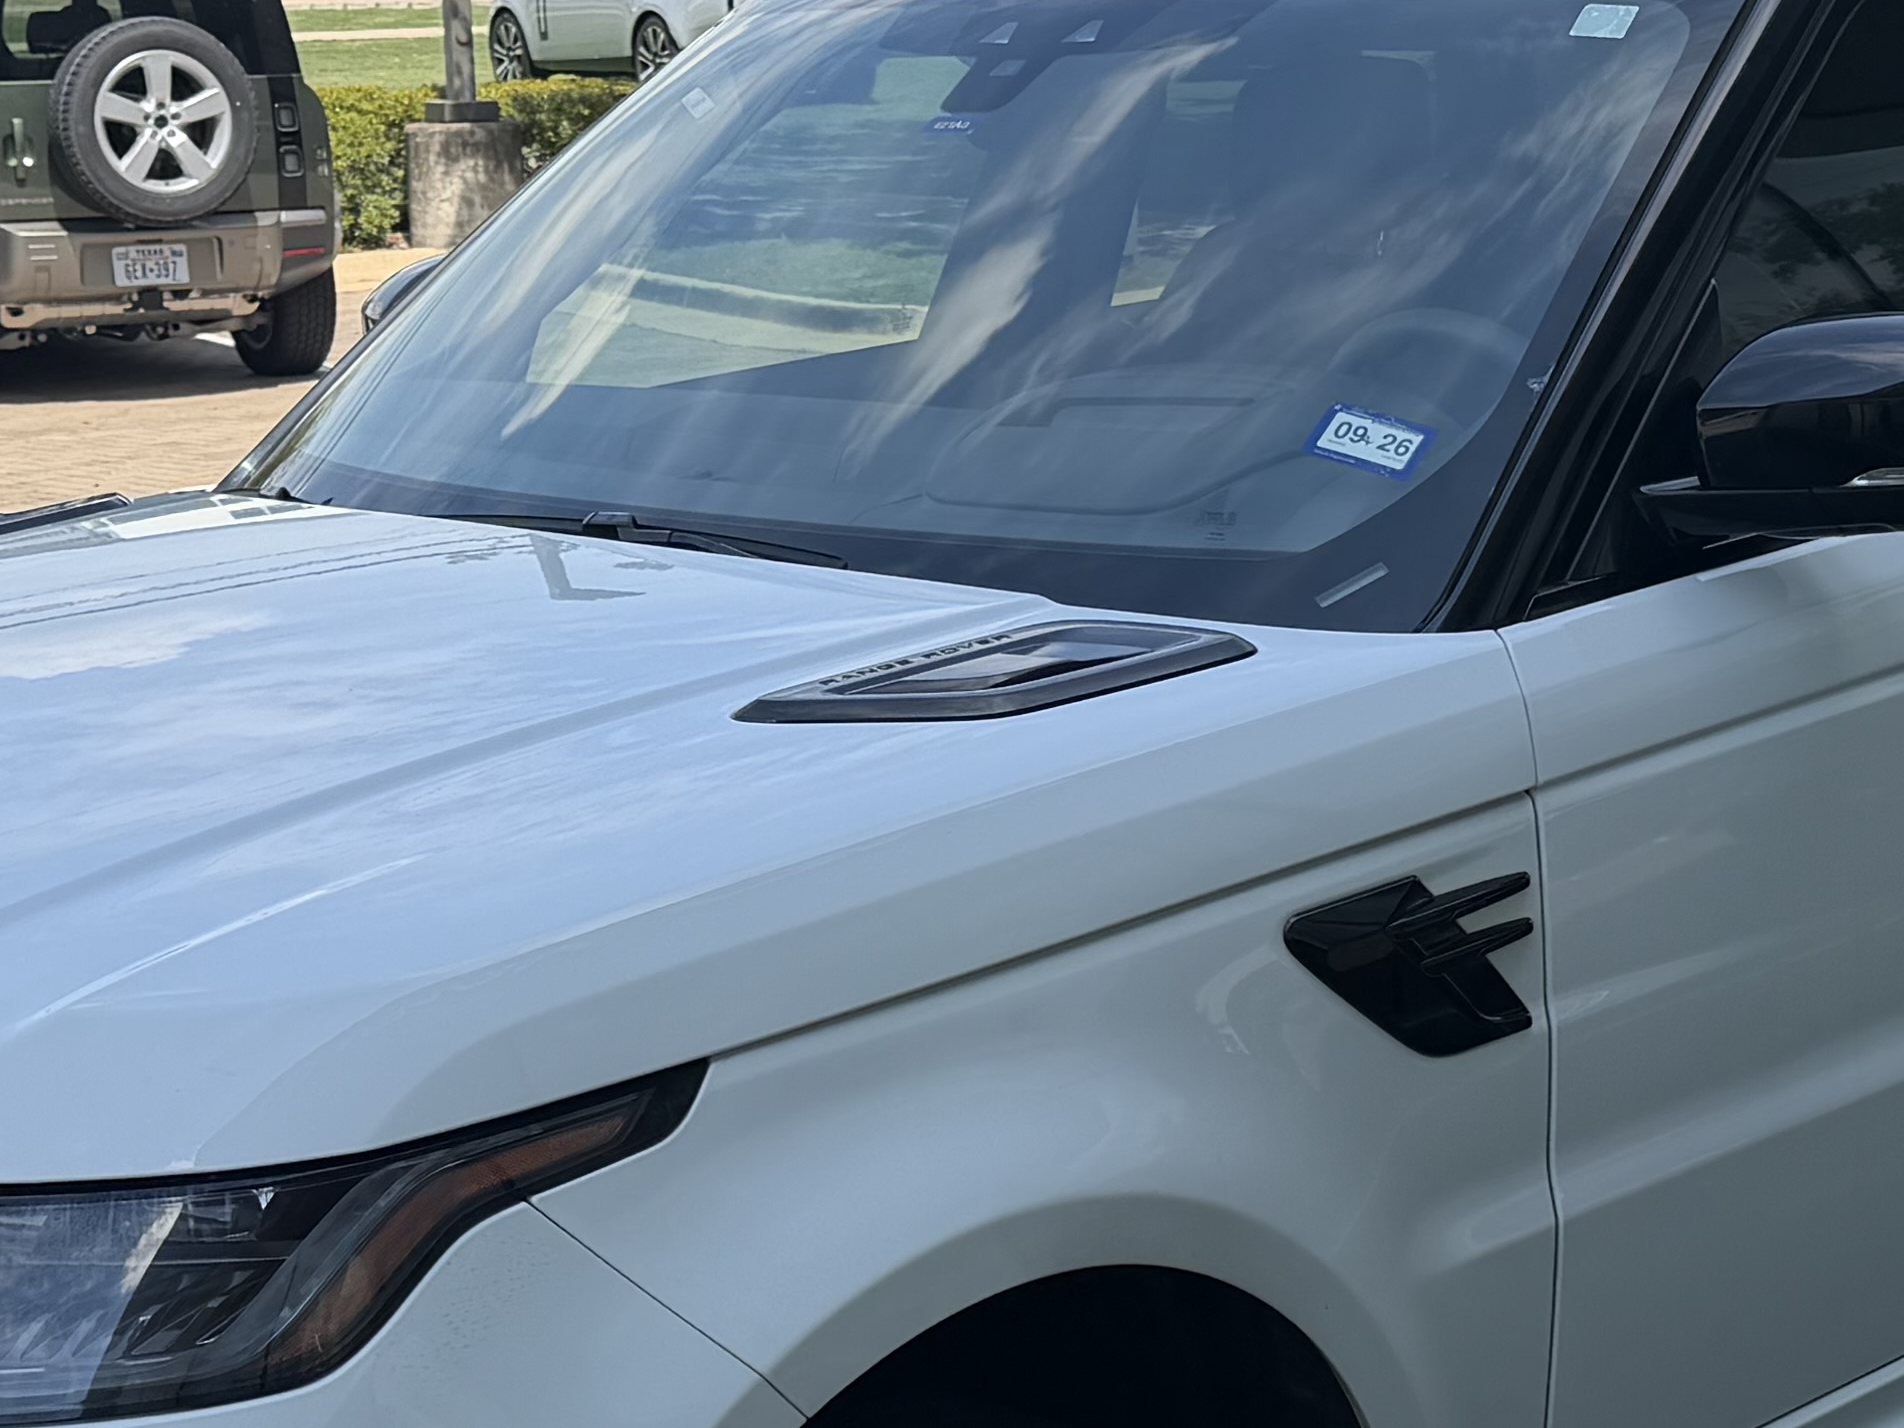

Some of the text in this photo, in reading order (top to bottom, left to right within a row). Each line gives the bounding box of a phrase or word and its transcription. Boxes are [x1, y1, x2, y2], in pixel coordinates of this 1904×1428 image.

[1333, 421, 1369, 444] 09
[1376, 433, 1414, 457] 26
[819, 634, 1012, 686] RANGE ROVER
